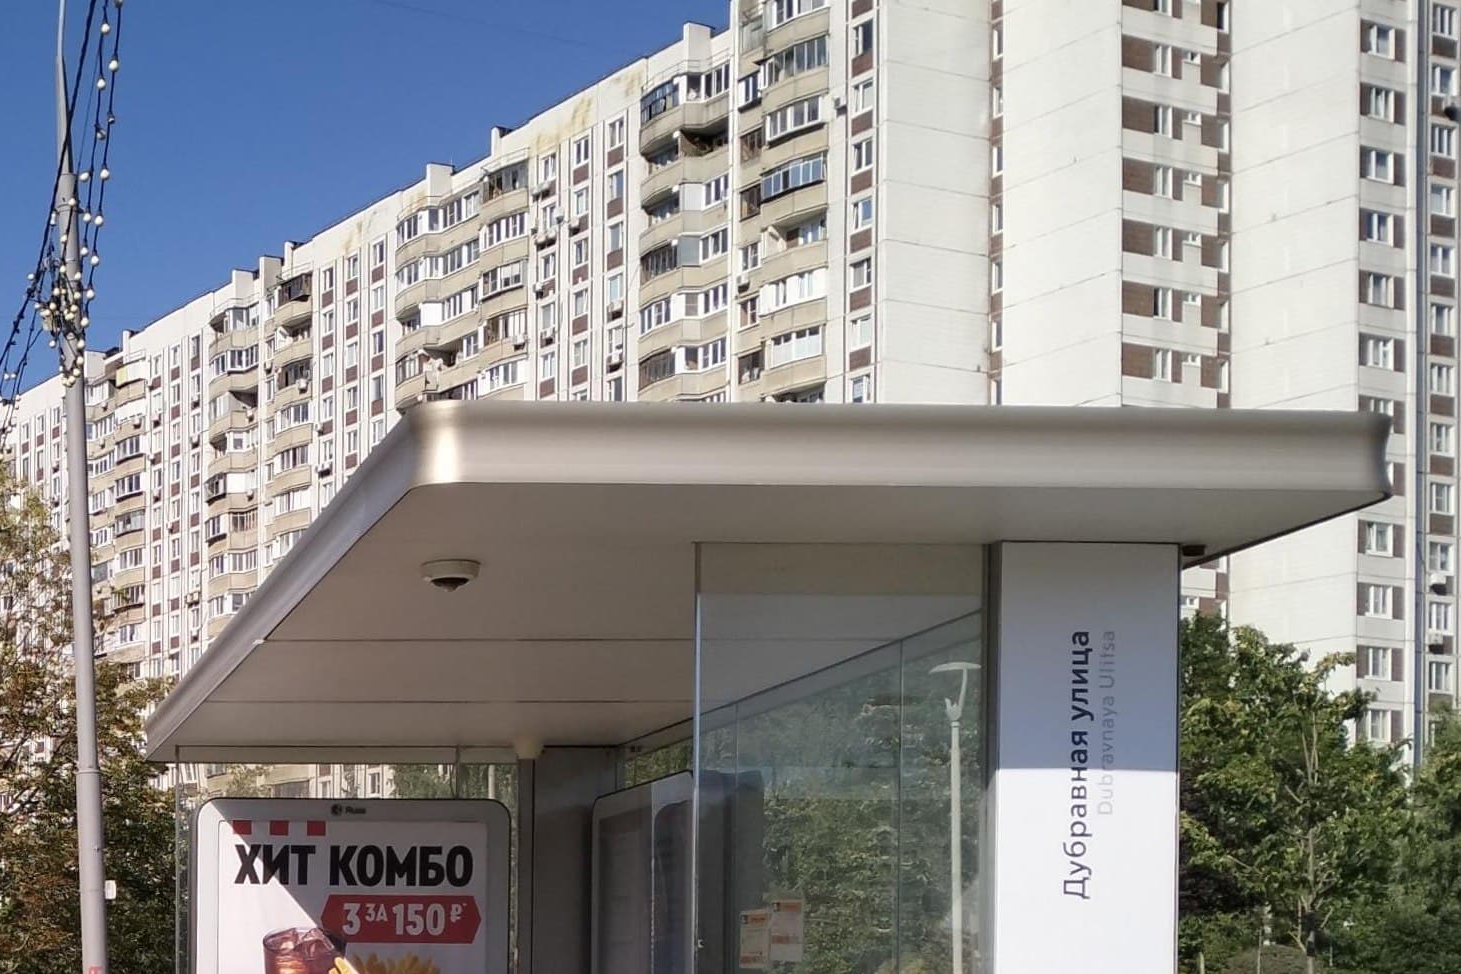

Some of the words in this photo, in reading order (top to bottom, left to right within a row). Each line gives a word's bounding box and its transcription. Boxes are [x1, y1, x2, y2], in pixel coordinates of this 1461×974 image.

[1070, 631, 1094, 721] улица
[1098, 630, 1116, 689] Ulitsa
[1097, 696, 1117, 816] Dubravnaya
[1063, 731, 1092, 899] Дубравная
[233, 843, 316, 885] ХИТ
[328, 845, 474, 887] КОМБО
[342, 903, 361, 936] 3
